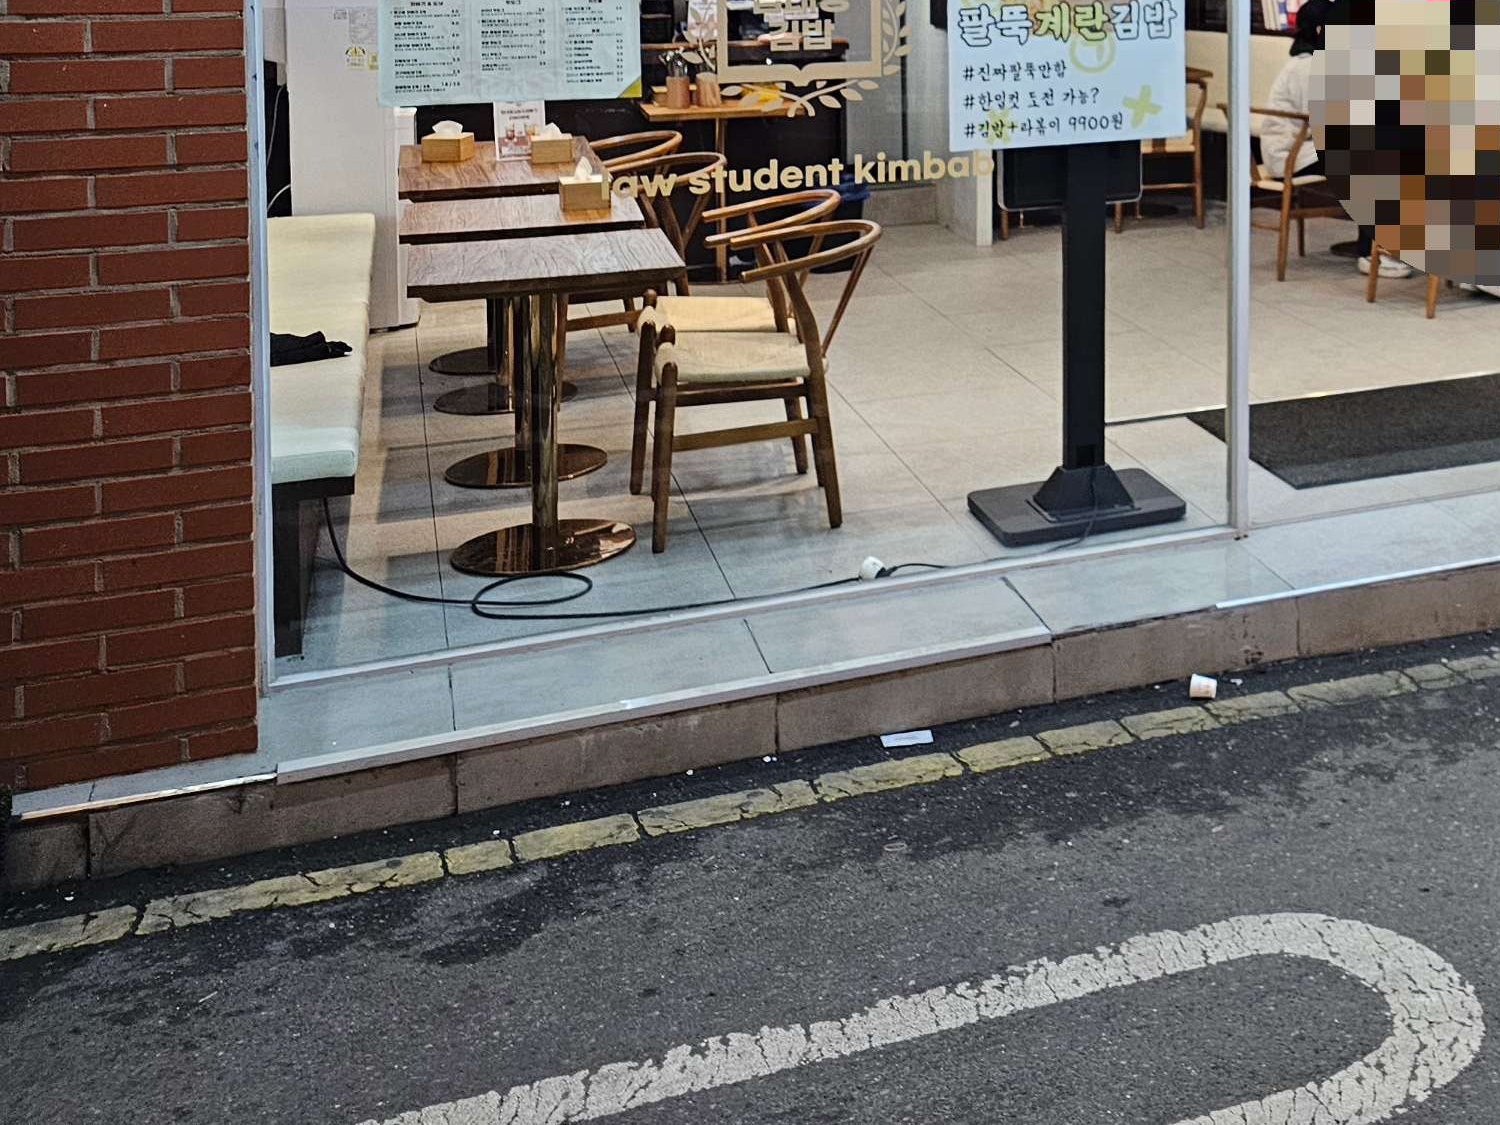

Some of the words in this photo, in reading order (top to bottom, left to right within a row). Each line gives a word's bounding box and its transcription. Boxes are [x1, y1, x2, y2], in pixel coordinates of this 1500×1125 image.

[769, 20, 837, 52] 김밥
[1027, 88, 1055, 109] 도전
[1062, 87, 1100, 107] 가능?
[1068, 112, 1123, 132] 9900원
[687, 158, 844, 195] student
[853, 148, 996, 185] kimbab
